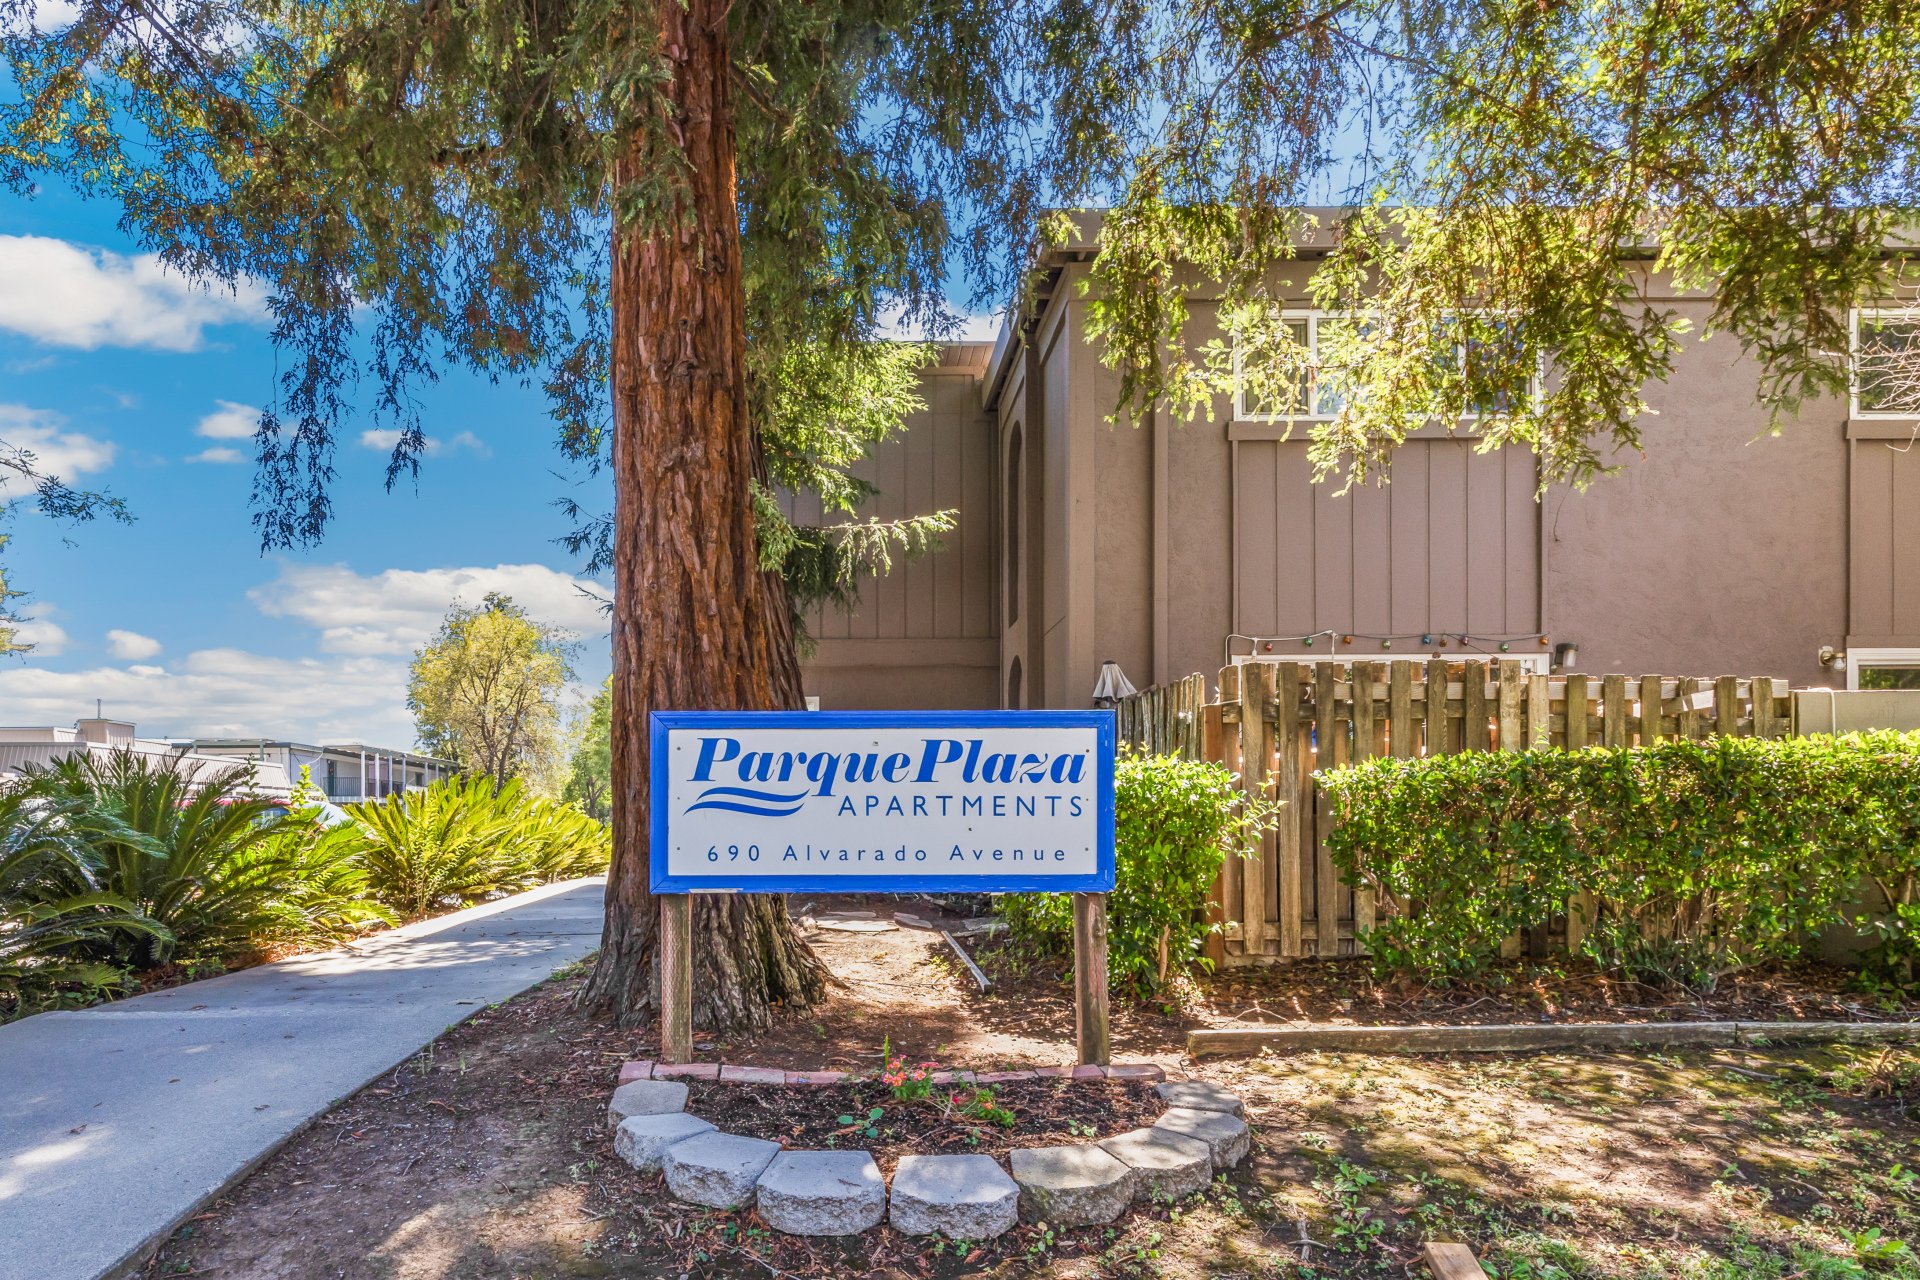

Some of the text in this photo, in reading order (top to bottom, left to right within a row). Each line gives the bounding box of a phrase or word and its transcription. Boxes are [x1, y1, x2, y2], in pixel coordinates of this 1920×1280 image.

[837, 795, 1082, 817] APARTMENTS
[707, 844, 1066, 862] 690 Alvarado Avenue
